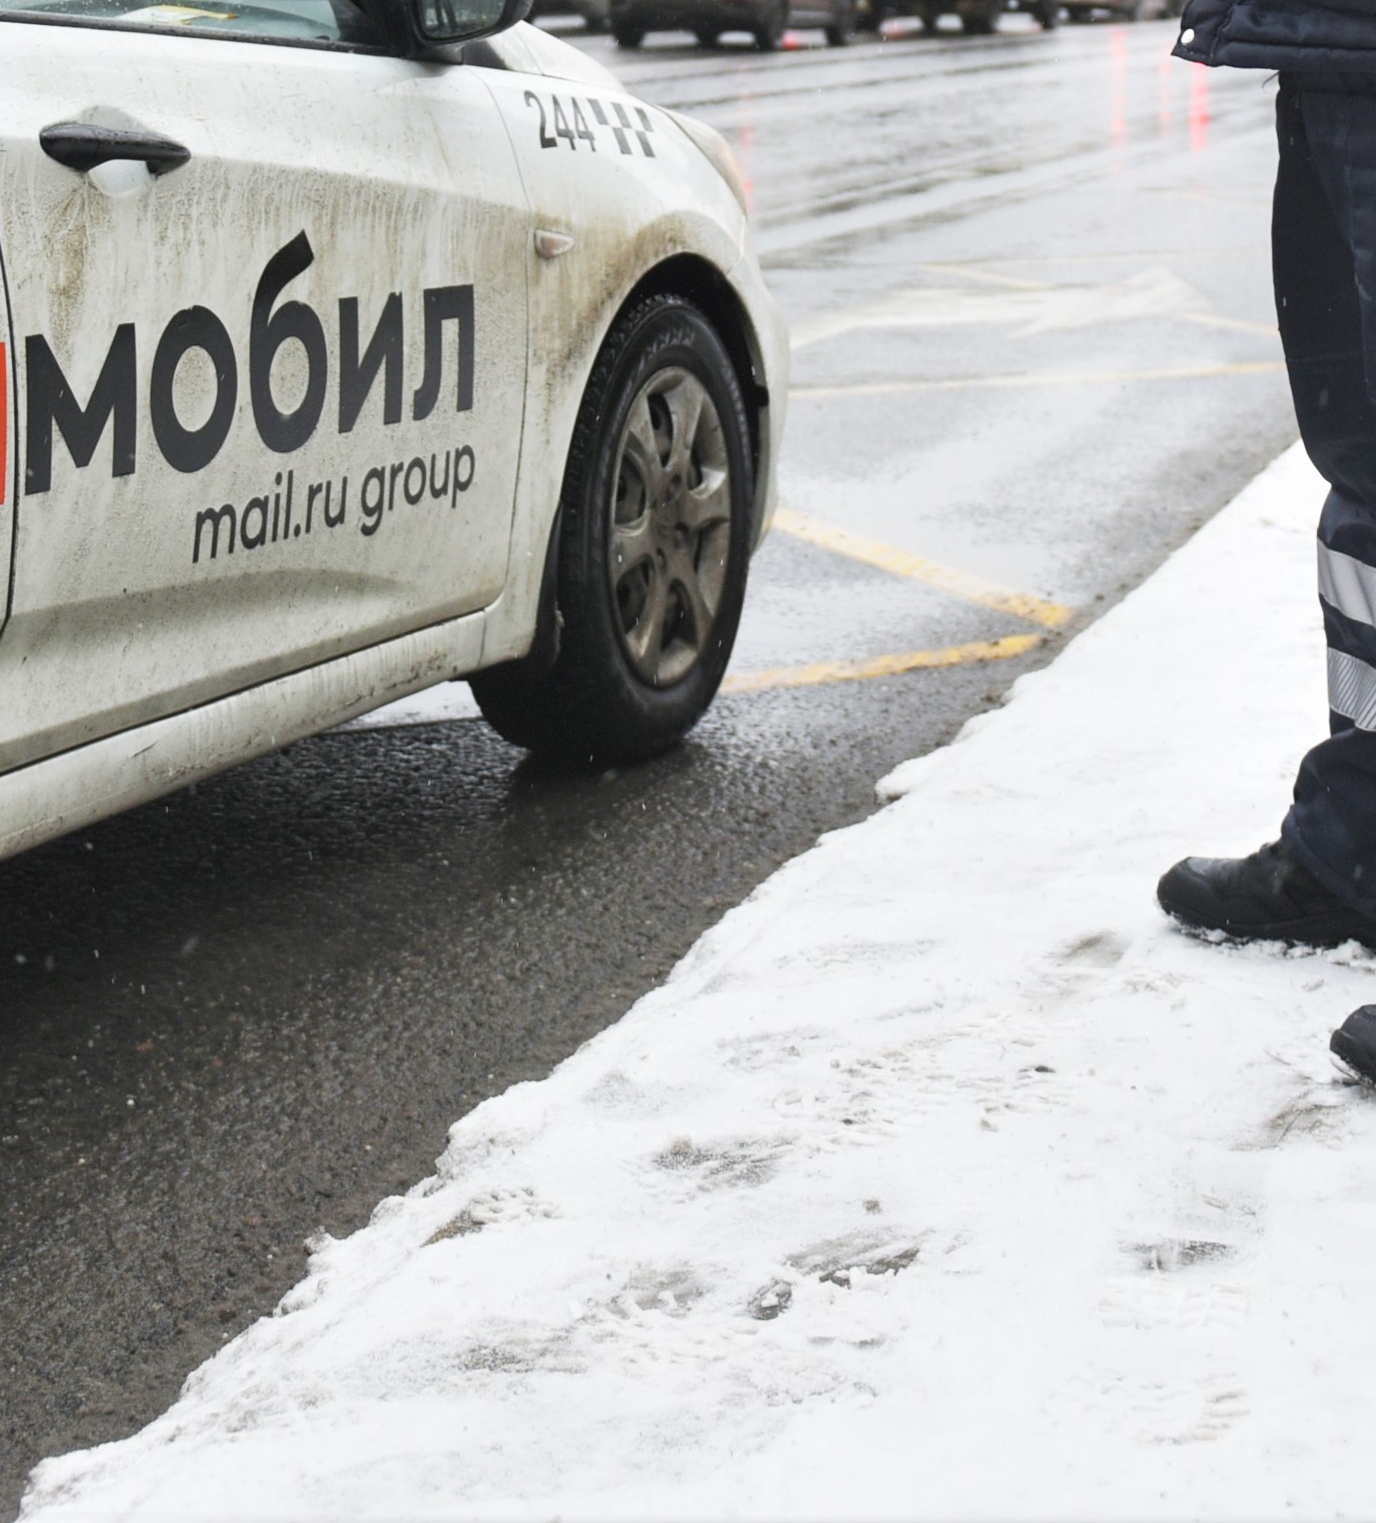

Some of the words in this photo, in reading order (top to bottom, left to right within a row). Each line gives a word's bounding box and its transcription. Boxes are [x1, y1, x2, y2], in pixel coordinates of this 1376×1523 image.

[523, 90, 597, 153] 244
[192, 469, 349, 564] mail.ru
[360, 444, 476, 537] group
